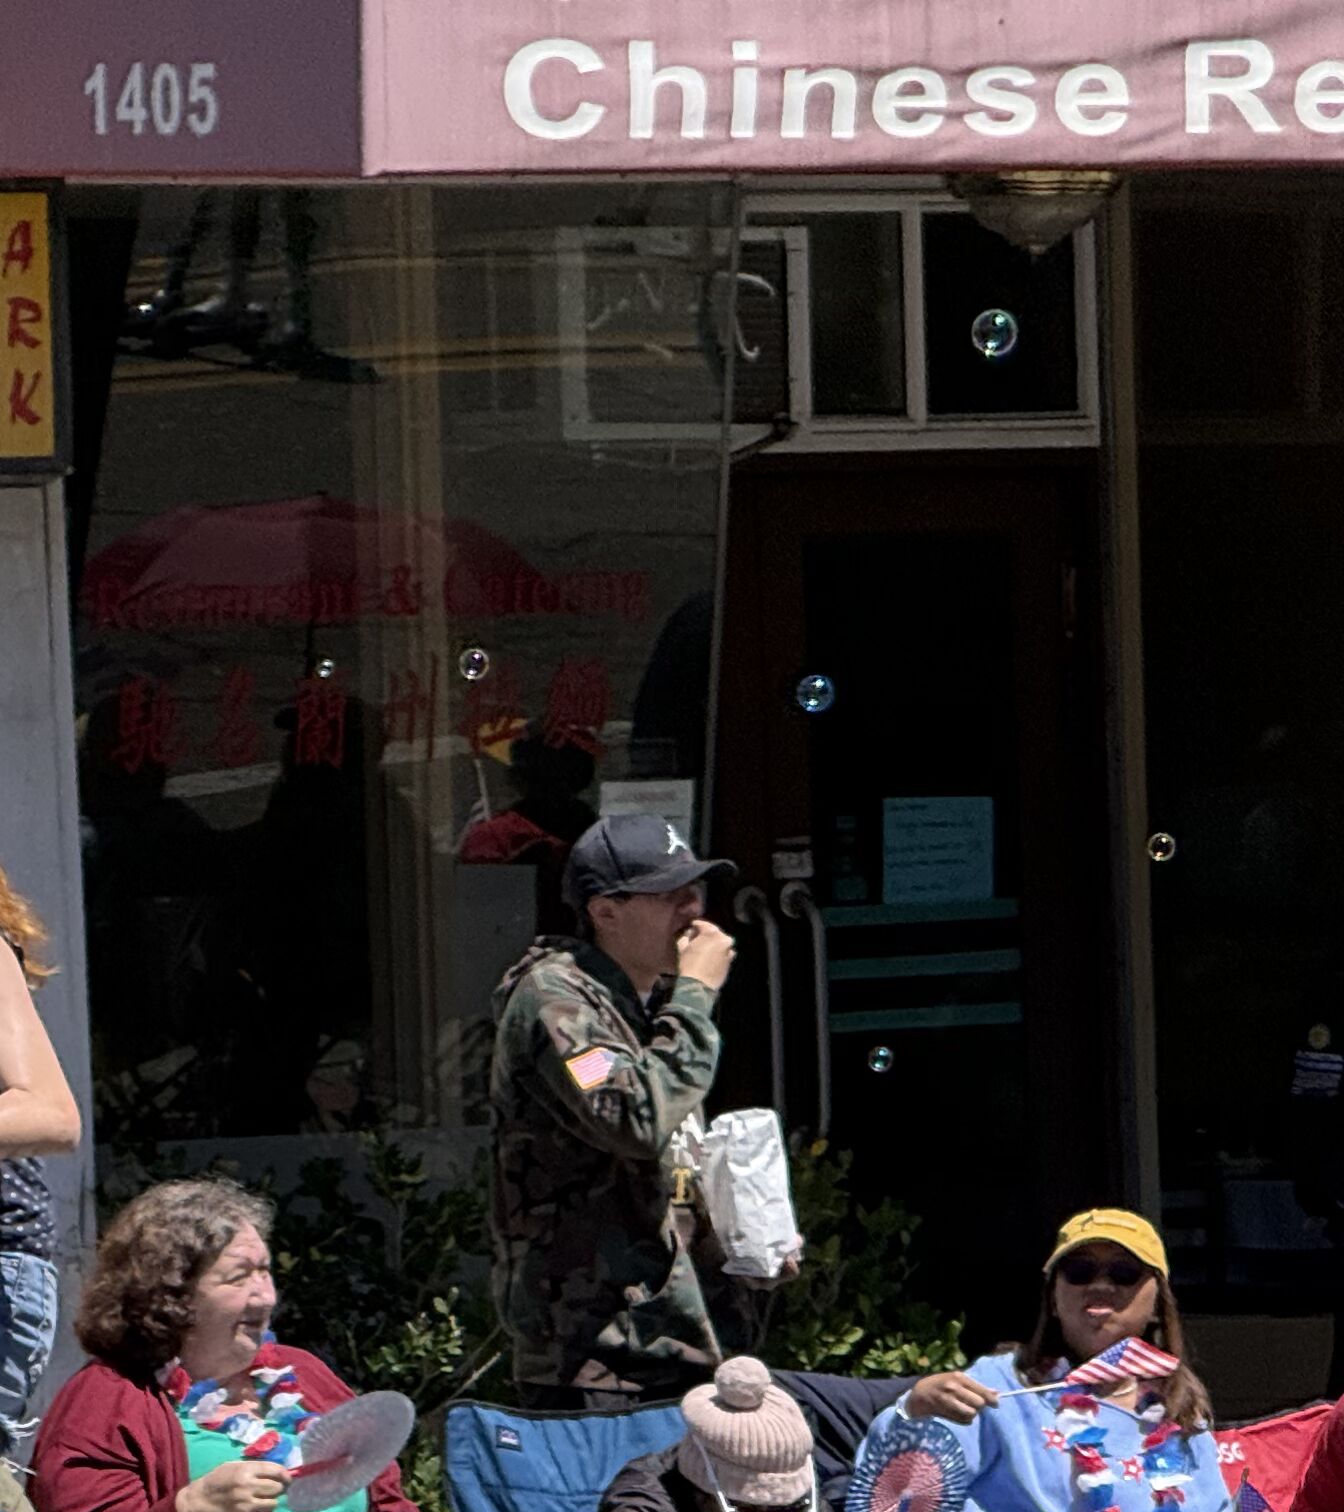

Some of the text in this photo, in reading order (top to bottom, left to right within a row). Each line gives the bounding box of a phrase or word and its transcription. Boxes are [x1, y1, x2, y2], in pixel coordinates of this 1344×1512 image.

[83, 61, 218, 137] 1405
[504, 36, 1130, 140] Chinese
[2, 219, 43, 426] ARK
